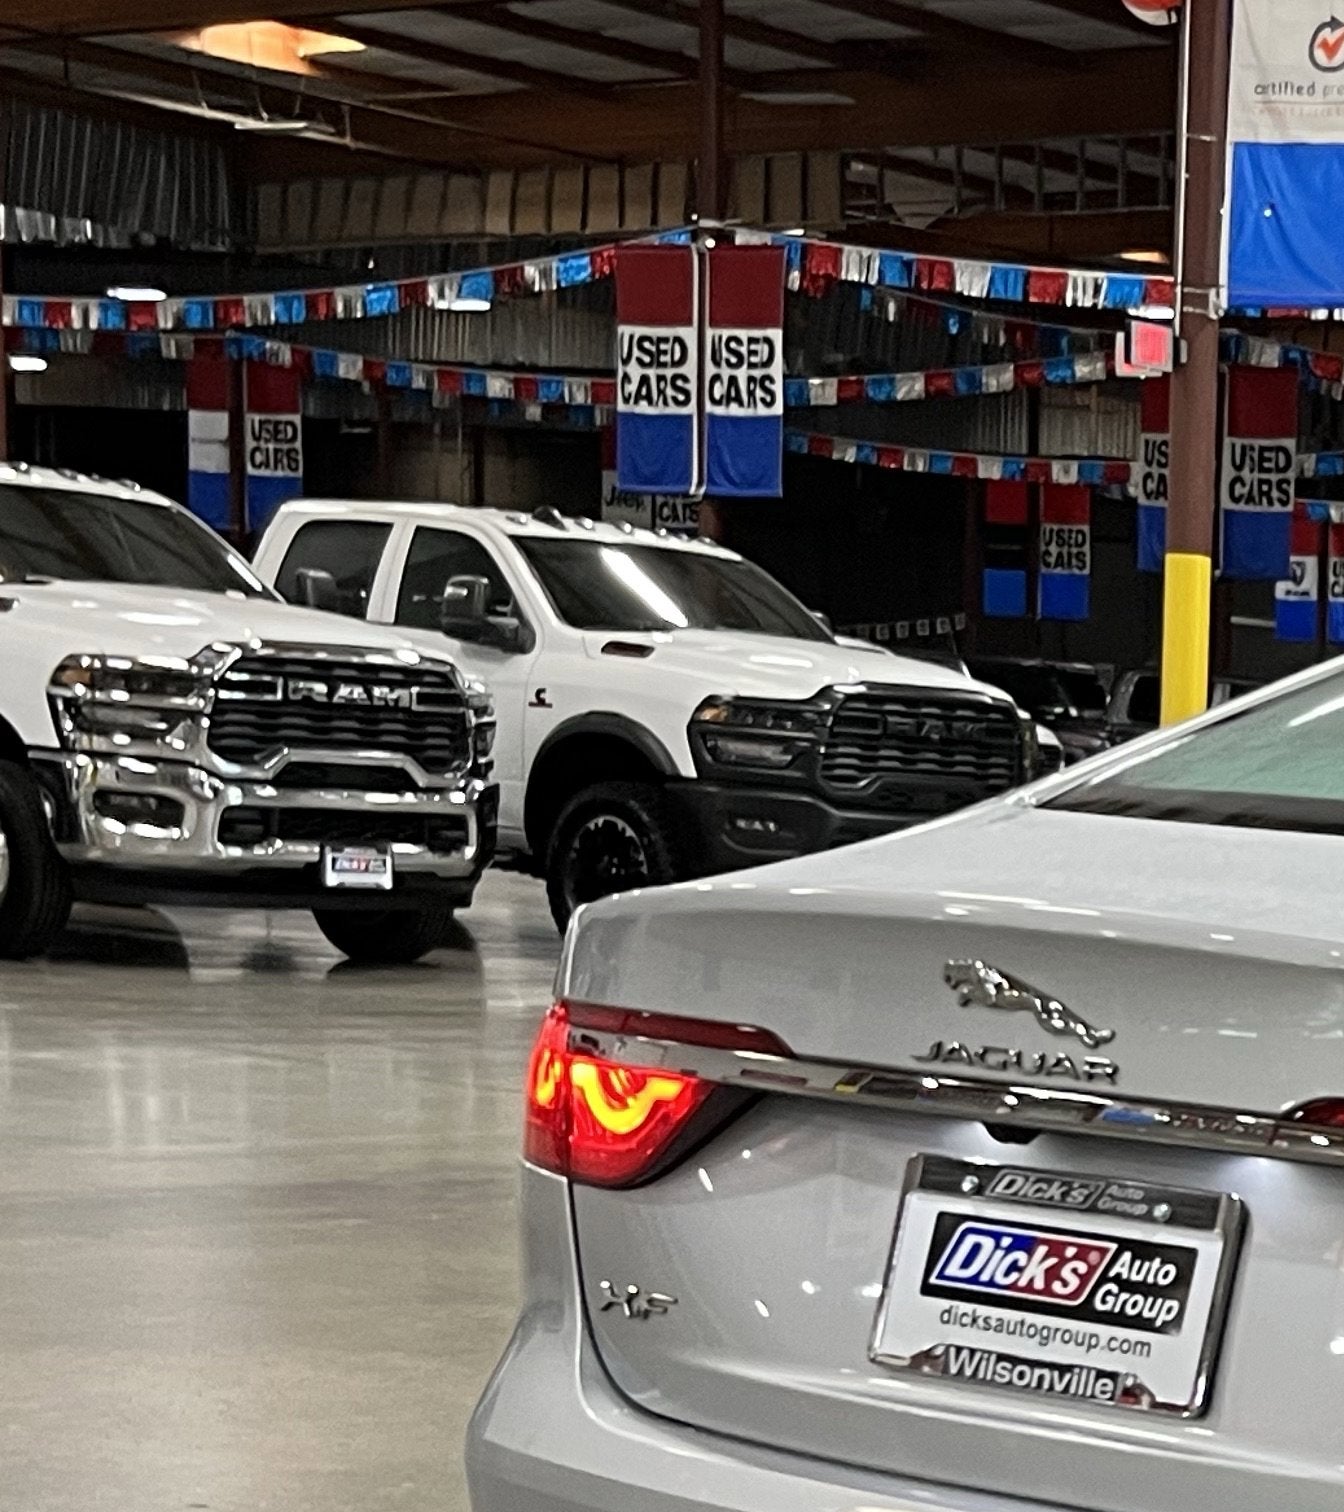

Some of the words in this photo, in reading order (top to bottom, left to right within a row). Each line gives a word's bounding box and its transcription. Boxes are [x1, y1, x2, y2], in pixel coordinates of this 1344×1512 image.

[620, 333, 689, 370] USED
[710, 334, 775, 370] USED
[619, 373, 692, 407] CARS
[708, 374, 777, 408] CARS
[250, 419, 298, 444] USED
[1229, 442, 1293, 474] USED
[1227, 474, 1292, 508] CARS
[1042, 528, 1087, 550] USED
[288, 680, 410, 707] RAM
[911, 1040, 1120, 1087] JAGUAR
[994, 1173, 1091, 1205] Dick's
[1106, 1184, 1145, 1200] Auto
[943, 1232, 1089, 1297] Dick's
[1108, 1250, 1177, 1286] Auto
[1093, 1283, 1180, 1327] Group
[939, 1304, 1152, 1358] dicksautogroup.com
[948, 1346, 1115, 1400] Wilsonville
